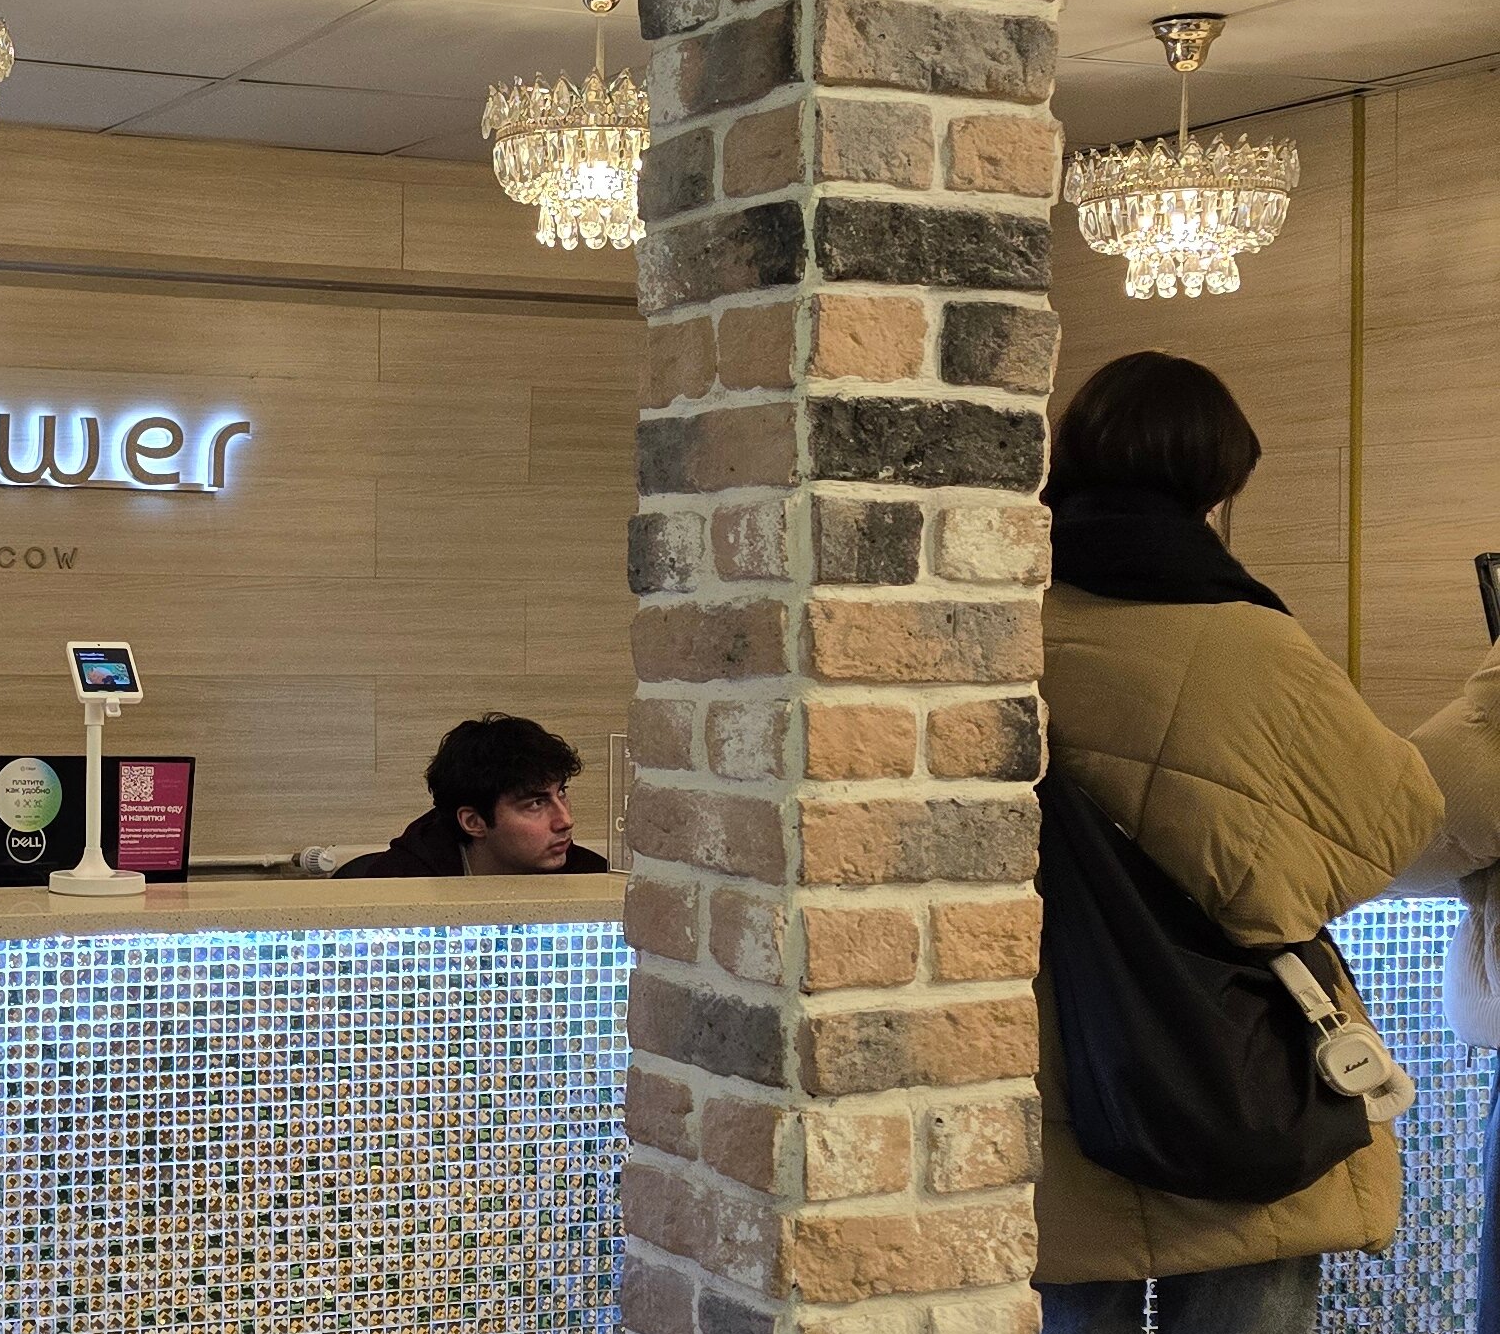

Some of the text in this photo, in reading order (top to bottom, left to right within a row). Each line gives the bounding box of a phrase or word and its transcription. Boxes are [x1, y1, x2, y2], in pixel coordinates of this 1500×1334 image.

[21, 786, 51, 796] удобно
[120, 804, 183, 814] Закажите еду
[129, 814, 166, 822] напитки
[11, 836, 42, 848] DELL
